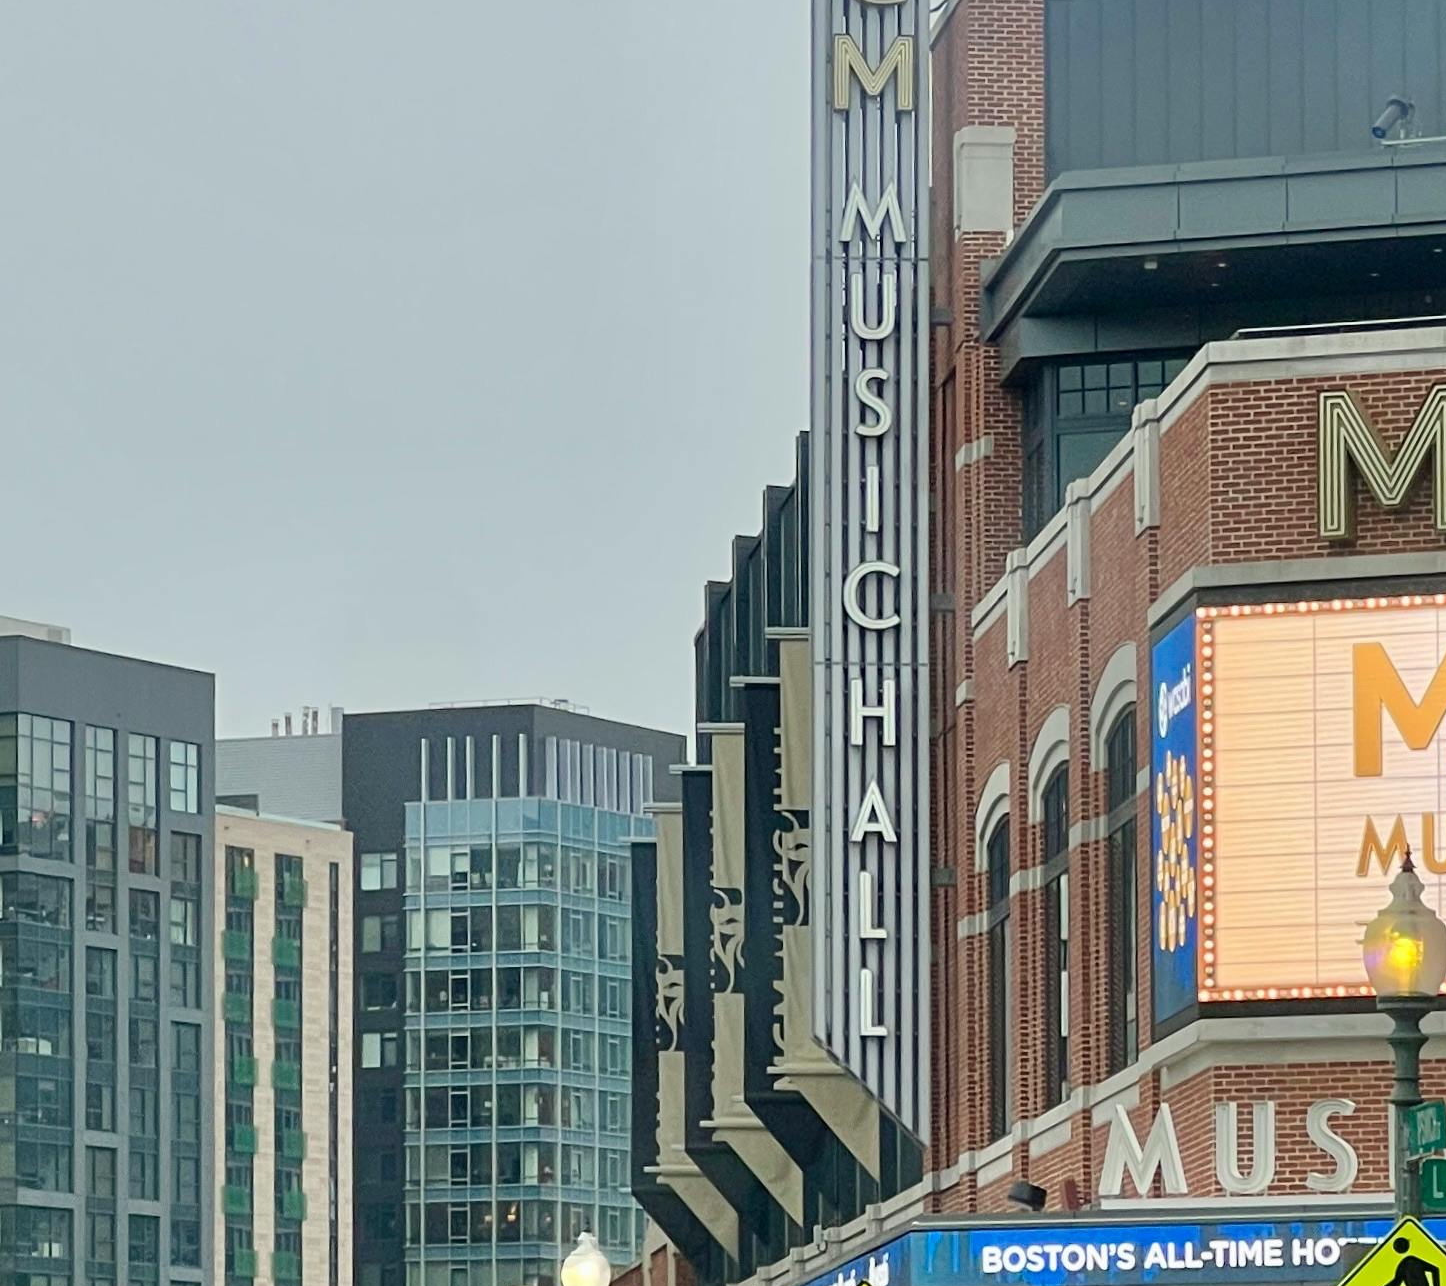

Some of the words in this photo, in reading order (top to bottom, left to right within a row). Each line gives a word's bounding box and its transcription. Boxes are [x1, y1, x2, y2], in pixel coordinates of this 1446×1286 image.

[839, 179, 907, 630] MUSIC
[849, 678, 898, 1037] HALL
[982, 1242, 1137, 1274] BOSTON'S
[1144, 1239, 1284, 1270] ALL-TIME
